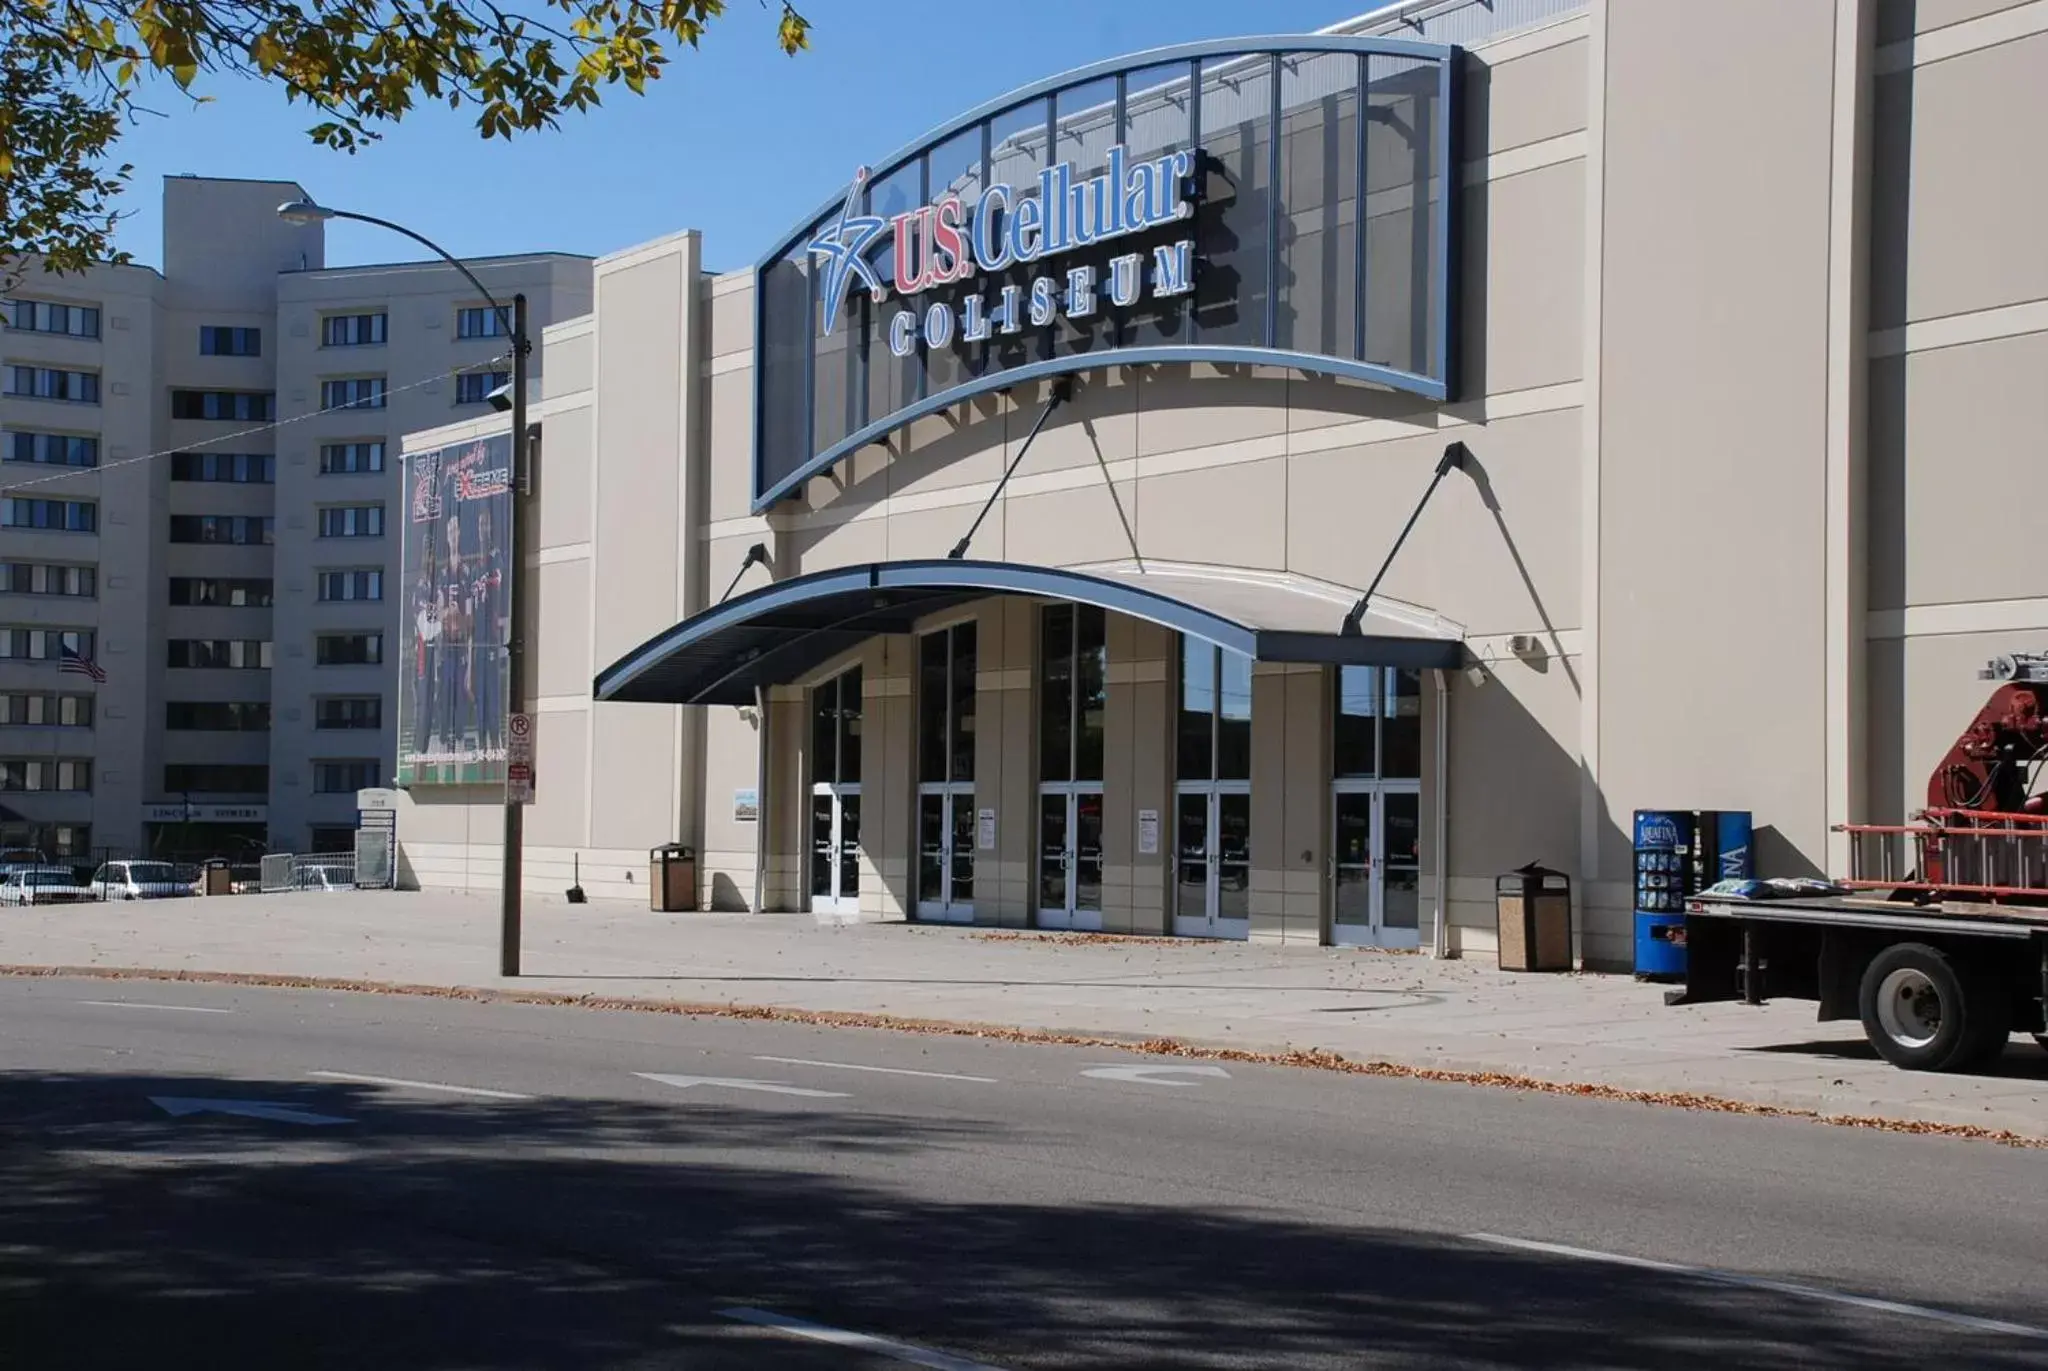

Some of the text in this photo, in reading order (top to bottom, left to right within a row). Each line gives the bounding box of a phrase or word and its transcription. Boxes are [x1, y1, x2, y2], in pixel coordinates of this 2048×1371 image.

[892, 197, 970, 294] U.S.
[890, 240, 1195, 357] COLISEUM
[153, 808, 258, 818] LINCON TOWERS
[1719, 845, 1747, 879] NA
